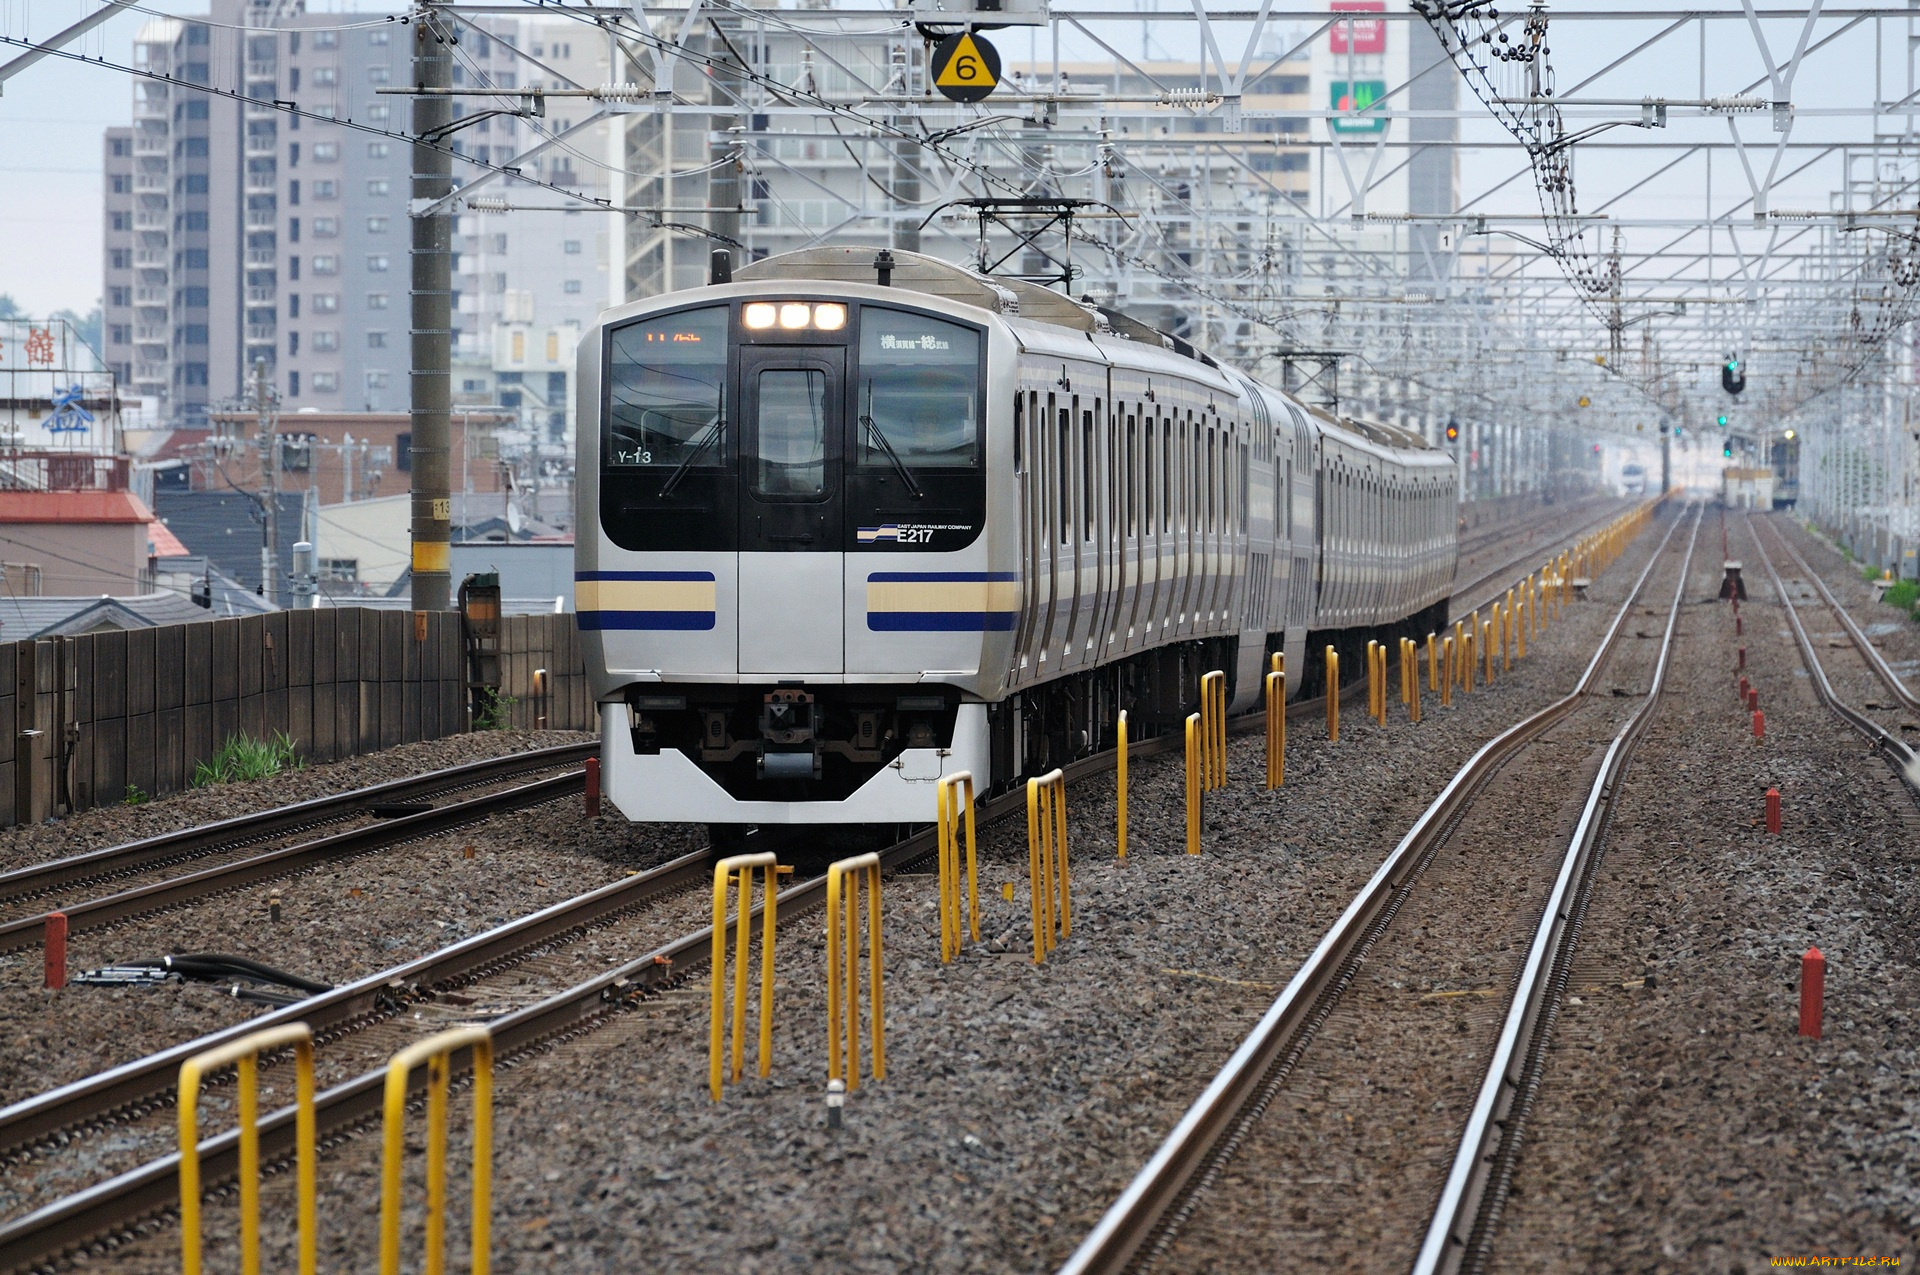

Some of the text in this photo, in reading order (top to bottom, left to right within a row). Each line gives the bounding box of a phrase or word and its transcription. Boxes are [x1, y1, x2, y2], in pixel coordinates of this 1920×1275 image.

[956, 55, 977, 81] 6
[1443, 235, 1449, 247] 1
[618, 450, 652, 464] Y-13
[897, 529, 934, 543] E217
